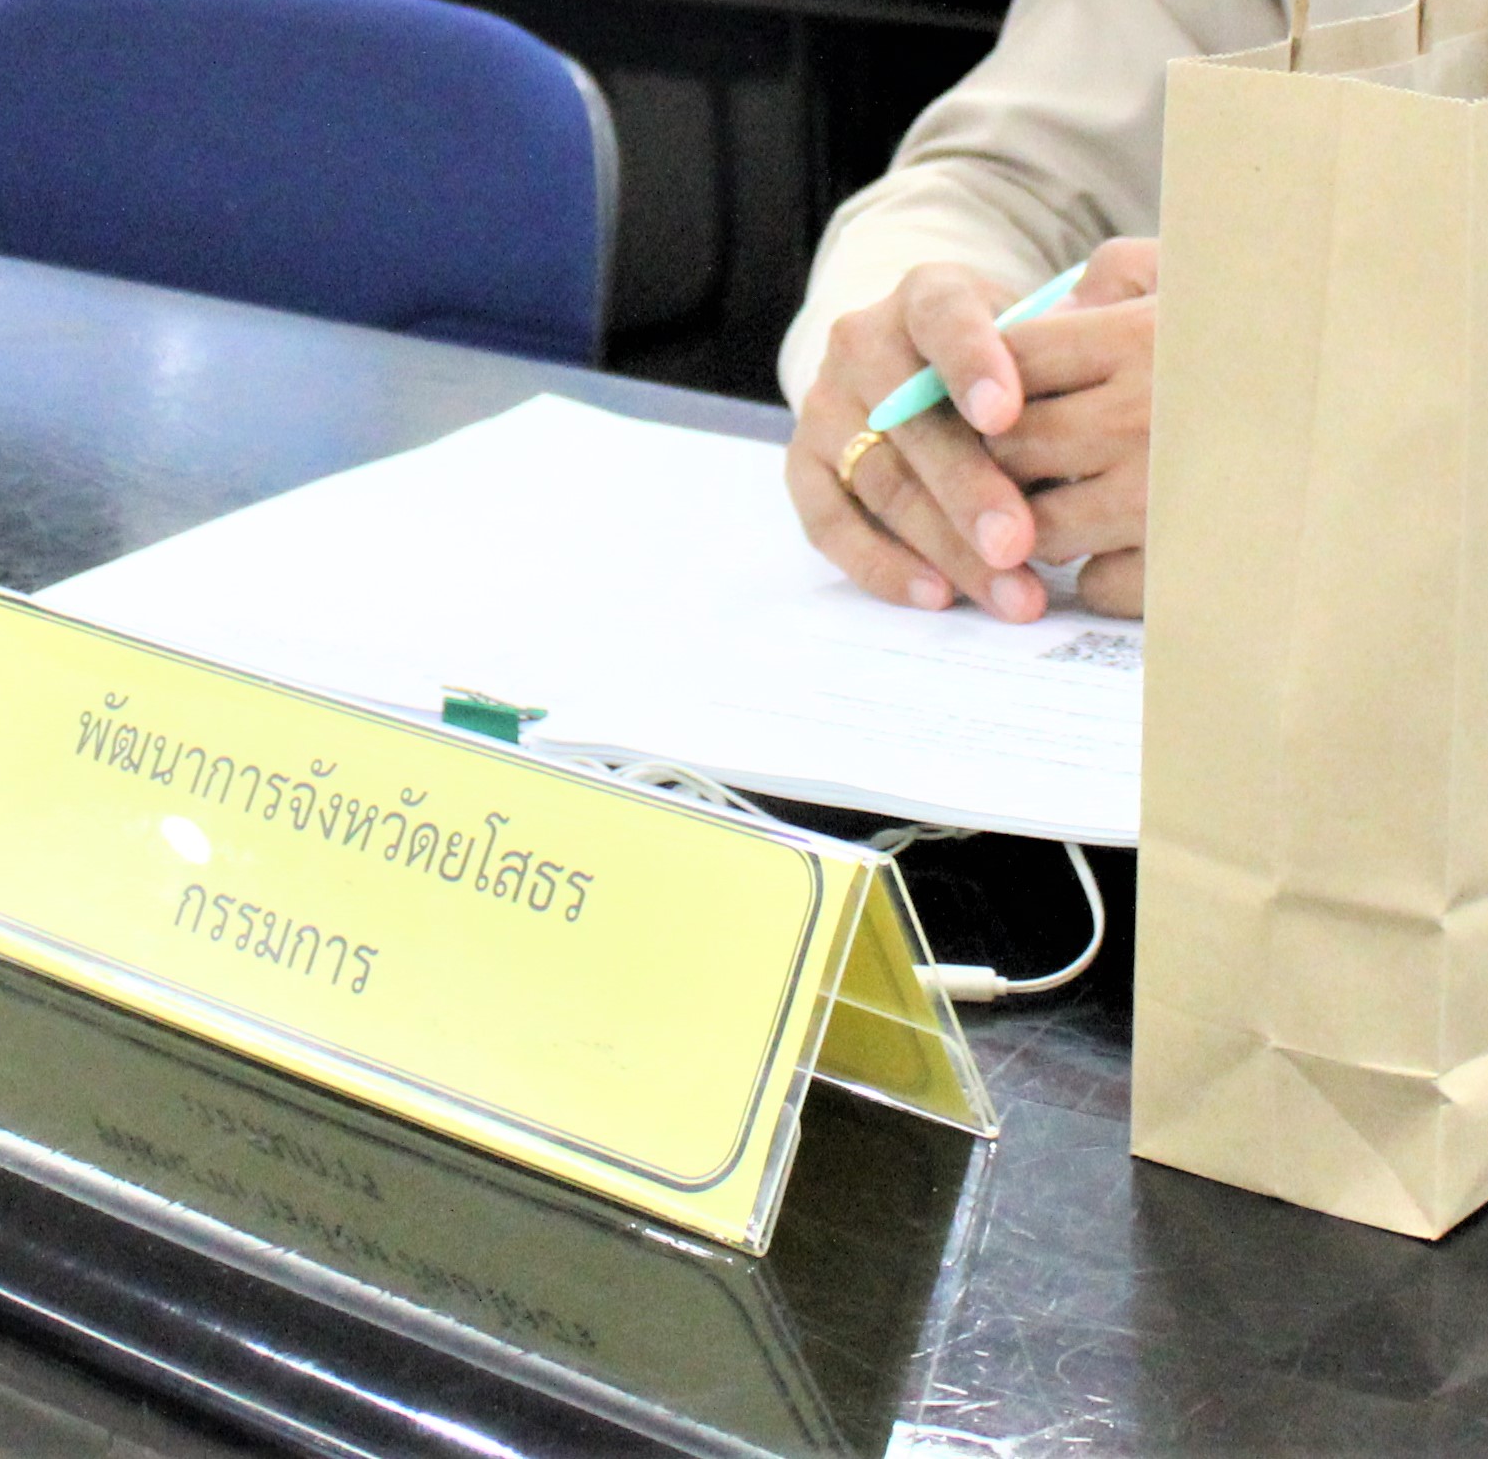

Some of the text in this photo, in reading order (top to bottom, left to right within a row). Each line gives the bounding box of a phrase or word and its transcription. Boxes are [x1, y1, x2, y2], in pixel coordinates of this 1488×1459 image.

[74, 690, 595, 923] พัฒนาการจังหวัดยโสธร
[172, 883, 380, 995] กรรมการ
